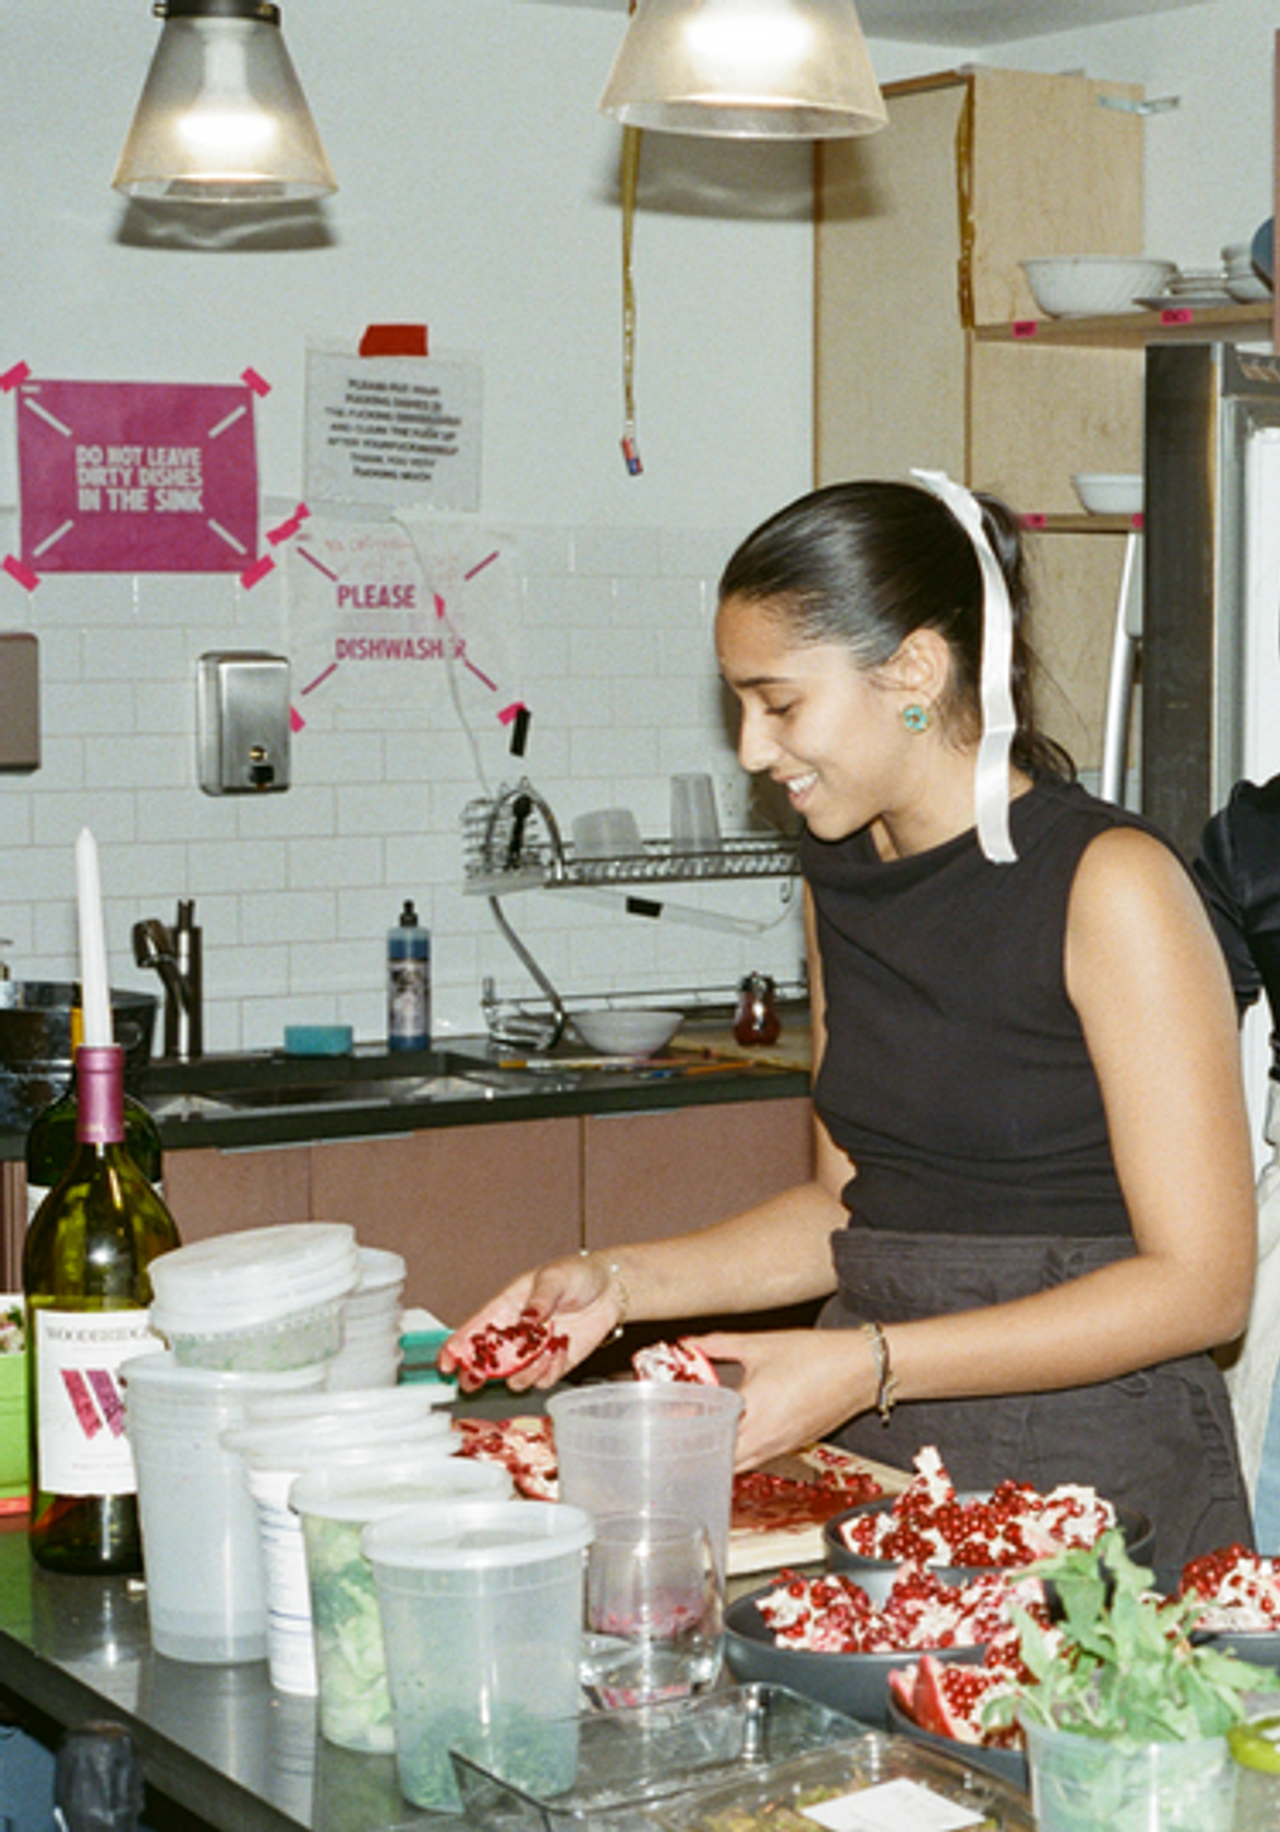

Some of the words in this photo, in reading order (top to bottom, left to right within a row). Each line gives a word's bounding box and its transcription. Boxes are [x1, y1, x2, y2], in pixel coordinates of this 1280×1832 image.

[75, 444, 104, 466] DO
[106, 445, 143, 467] NOT
[147, 447, 203, 467] LEAVE
[77, 467, 134, 487] DIRTY
[139, 467, 203, 488] DISHES
[78, 488, 101, 512] IN
[105, 488, 149, 512] THE
[153, 488, 204, 513] SINK
[336, 584, 416, 610] PLEASE
[334, 637, 467, 661] DISHWASHR
